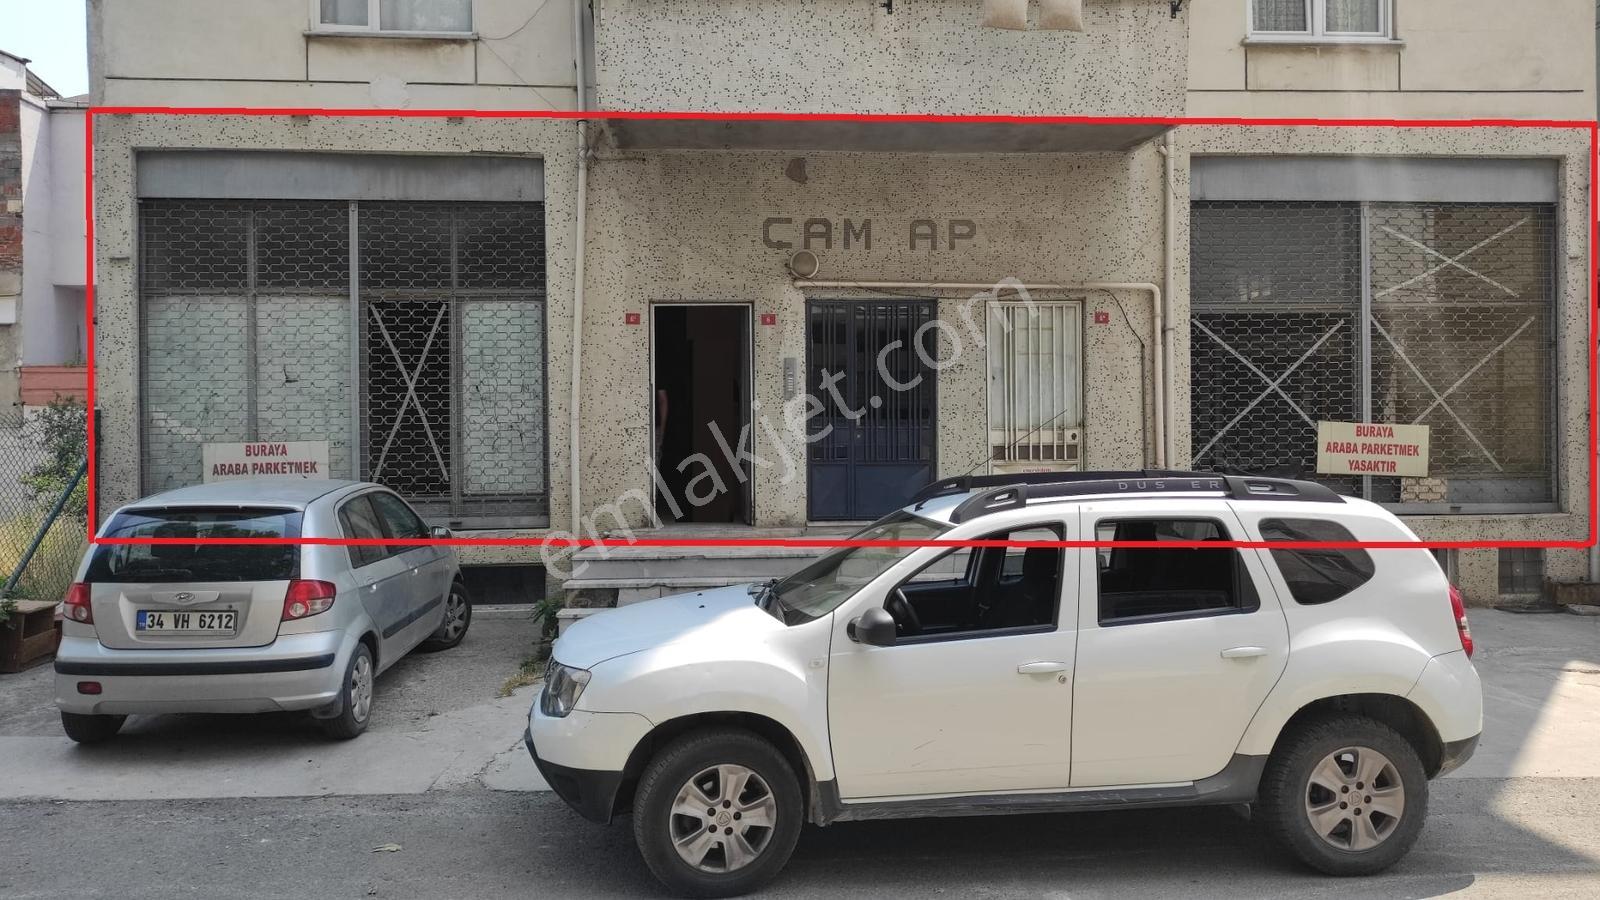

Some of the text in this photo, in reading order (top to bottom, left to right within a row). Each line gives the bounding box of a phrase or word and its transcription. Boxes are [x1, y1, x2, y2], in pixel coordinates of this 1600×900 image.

[909, 219, 977, 250] AP
[1355, 425, 1394, 438] BURAYA
[245, 444, 288, 456] BURAYA
[1325, 442, 1419, 456] ARABA PARKETMEK
[212, 461, 318, 476] ARABA PARKETMEK
[1348, 459, 1397, 473] YASAKTIR
[147, 614, 164, 628] 34
[173, 614, 190, 628] VH
[199, 614, 233, 628] 6212
